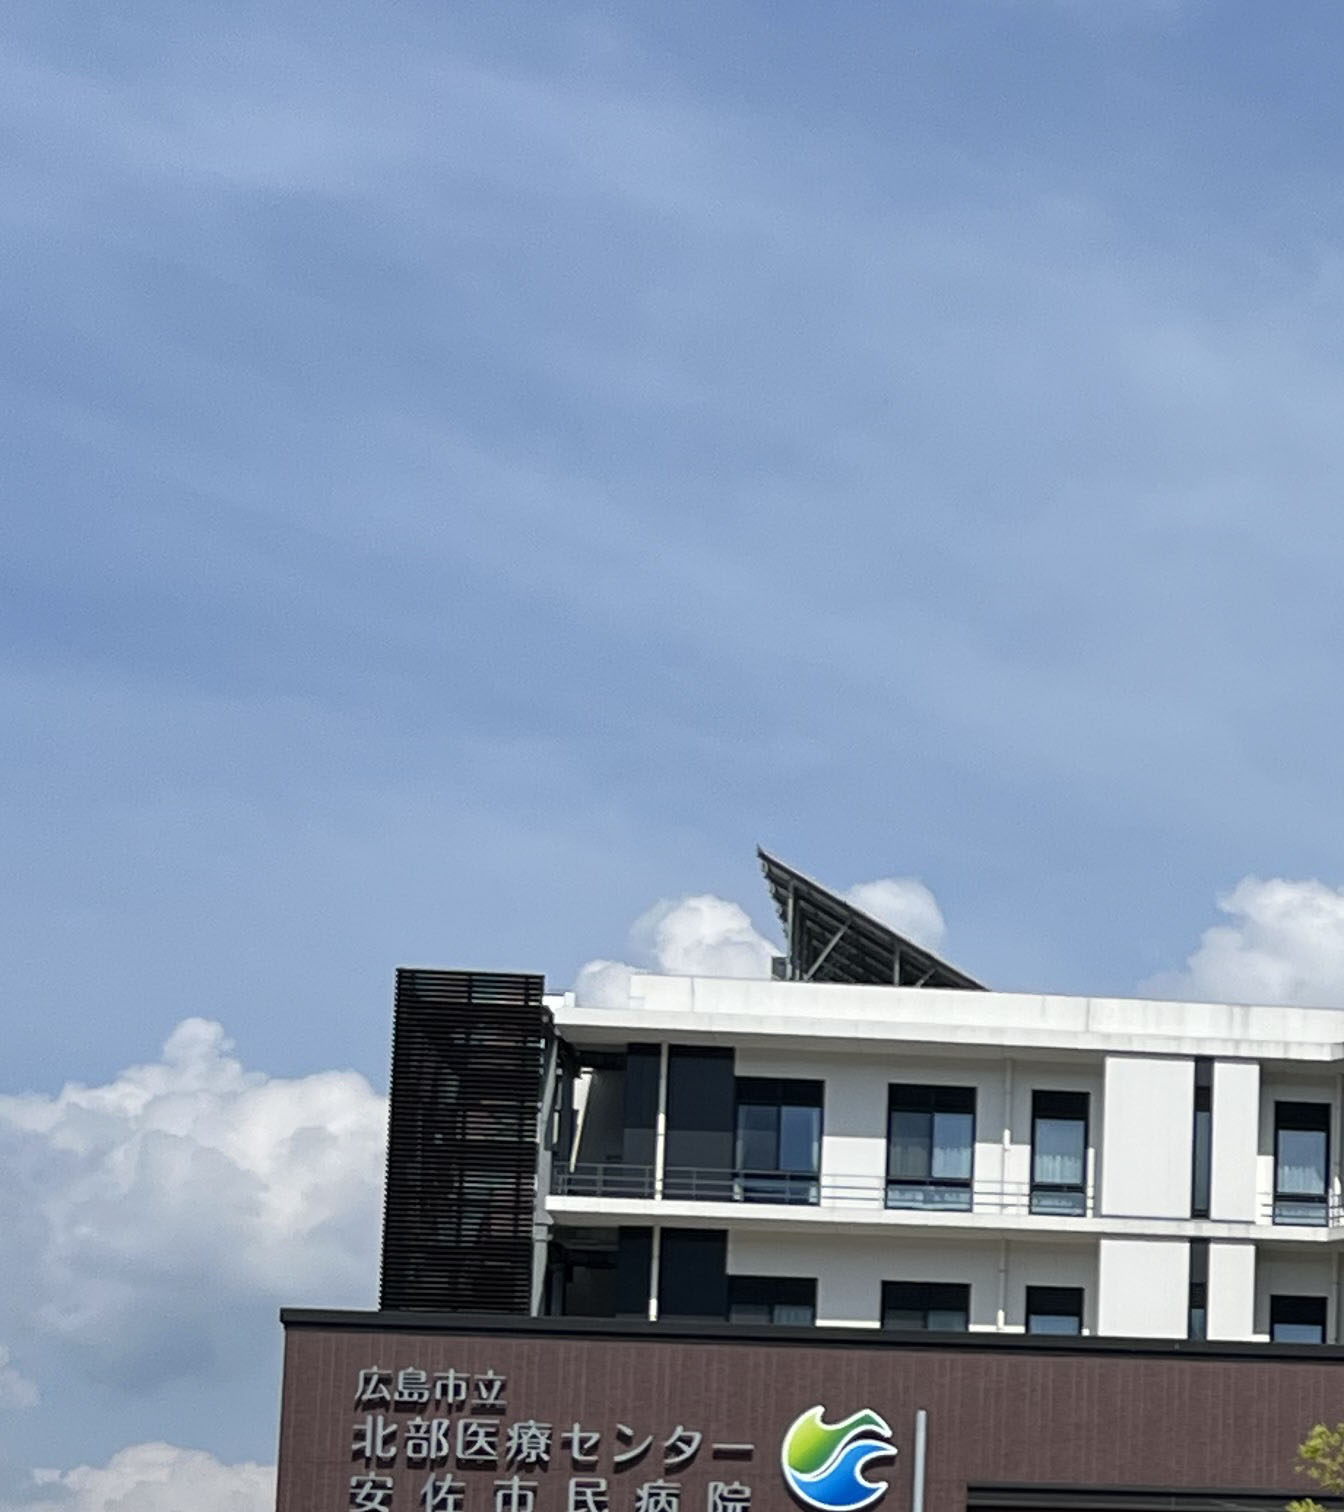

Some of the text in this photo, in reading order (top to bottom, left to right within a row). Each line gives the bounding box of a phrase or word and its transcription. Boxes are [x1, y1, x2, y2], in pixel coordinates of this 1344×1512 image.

[354, 1366, 507, 1405] 広島市立
[352, 1415, 754, 1464] 北部医療センター
